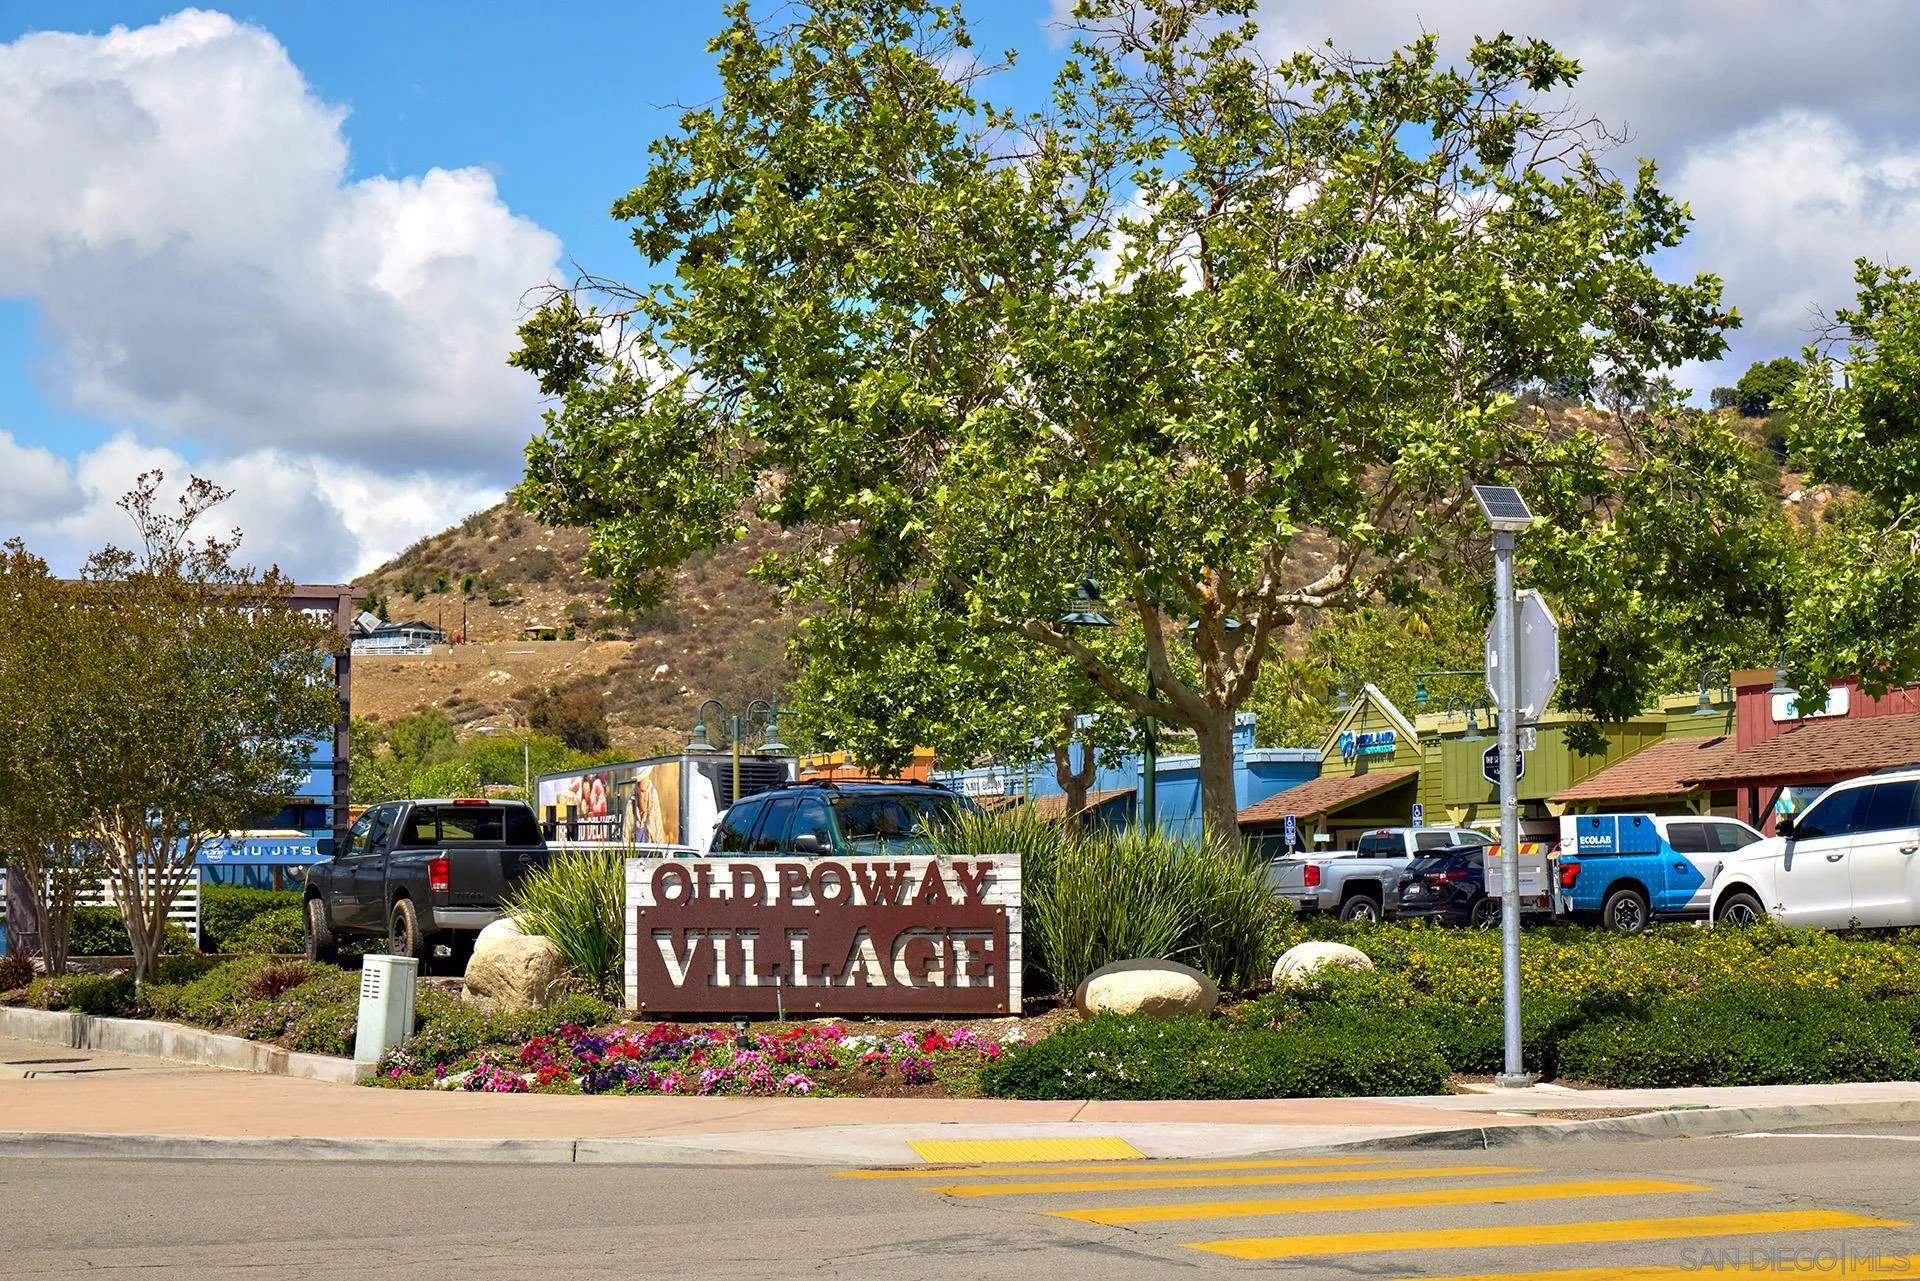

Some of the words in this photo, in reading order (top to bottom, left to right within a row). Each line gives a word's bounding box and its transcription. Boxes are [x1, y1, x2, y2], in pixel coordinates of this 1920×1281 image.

[231, 846, 261, 856] JIU
[1579, 835, 1612, 845] ECOLAB
[651, 862, 768, 907] OLD
[775, 860, 994, 907] POWAY
[651, 925, 996, 988] VILLAGE
